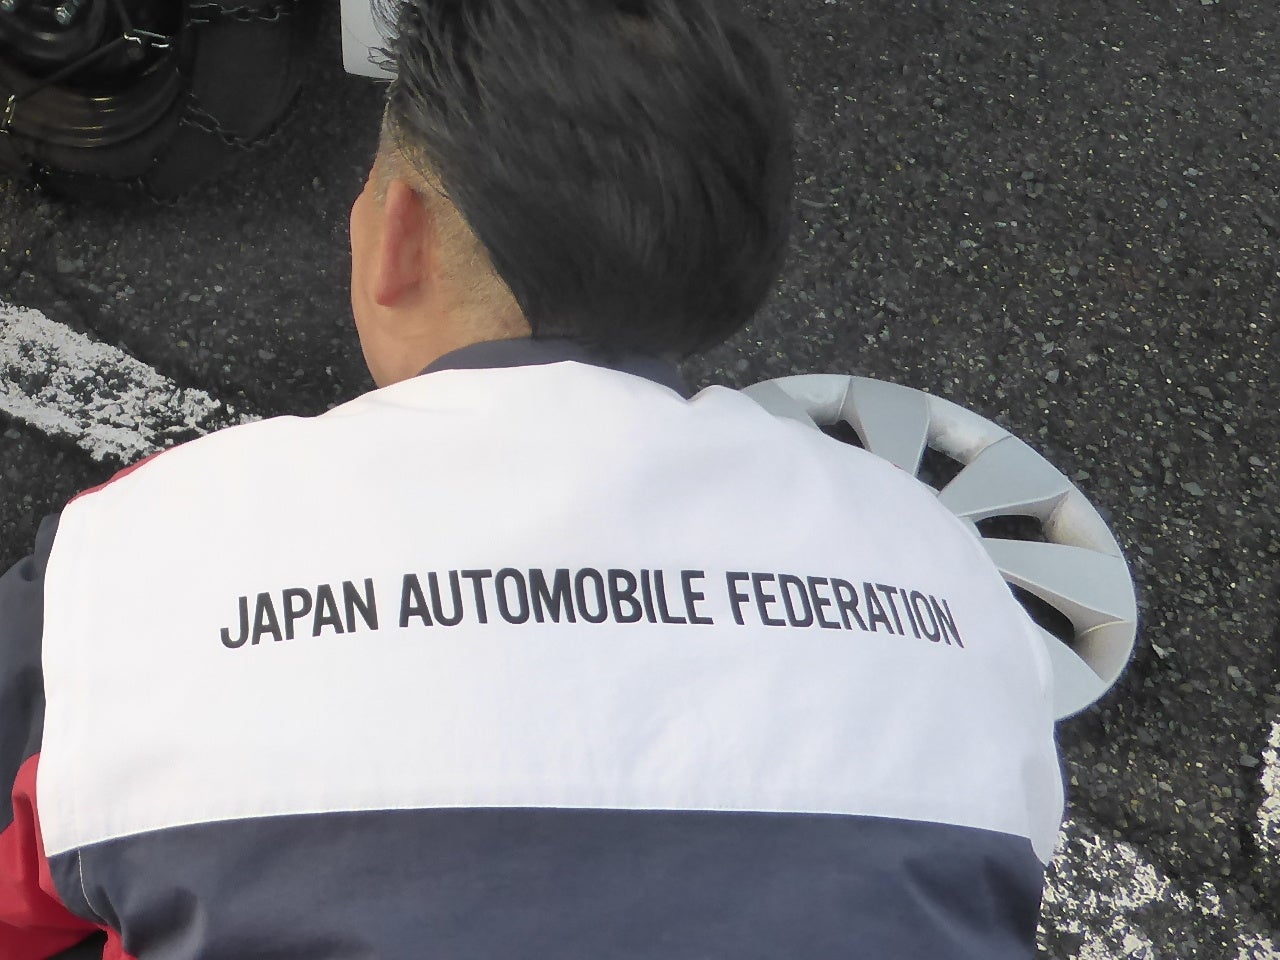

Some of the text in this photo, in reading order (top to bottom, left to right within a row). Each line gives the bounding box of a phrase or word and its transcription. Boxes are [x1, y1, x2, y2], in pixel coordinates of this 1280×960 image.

[221, 568, 964, 648] JAPAN AUTOMOBILE FEDERATION
